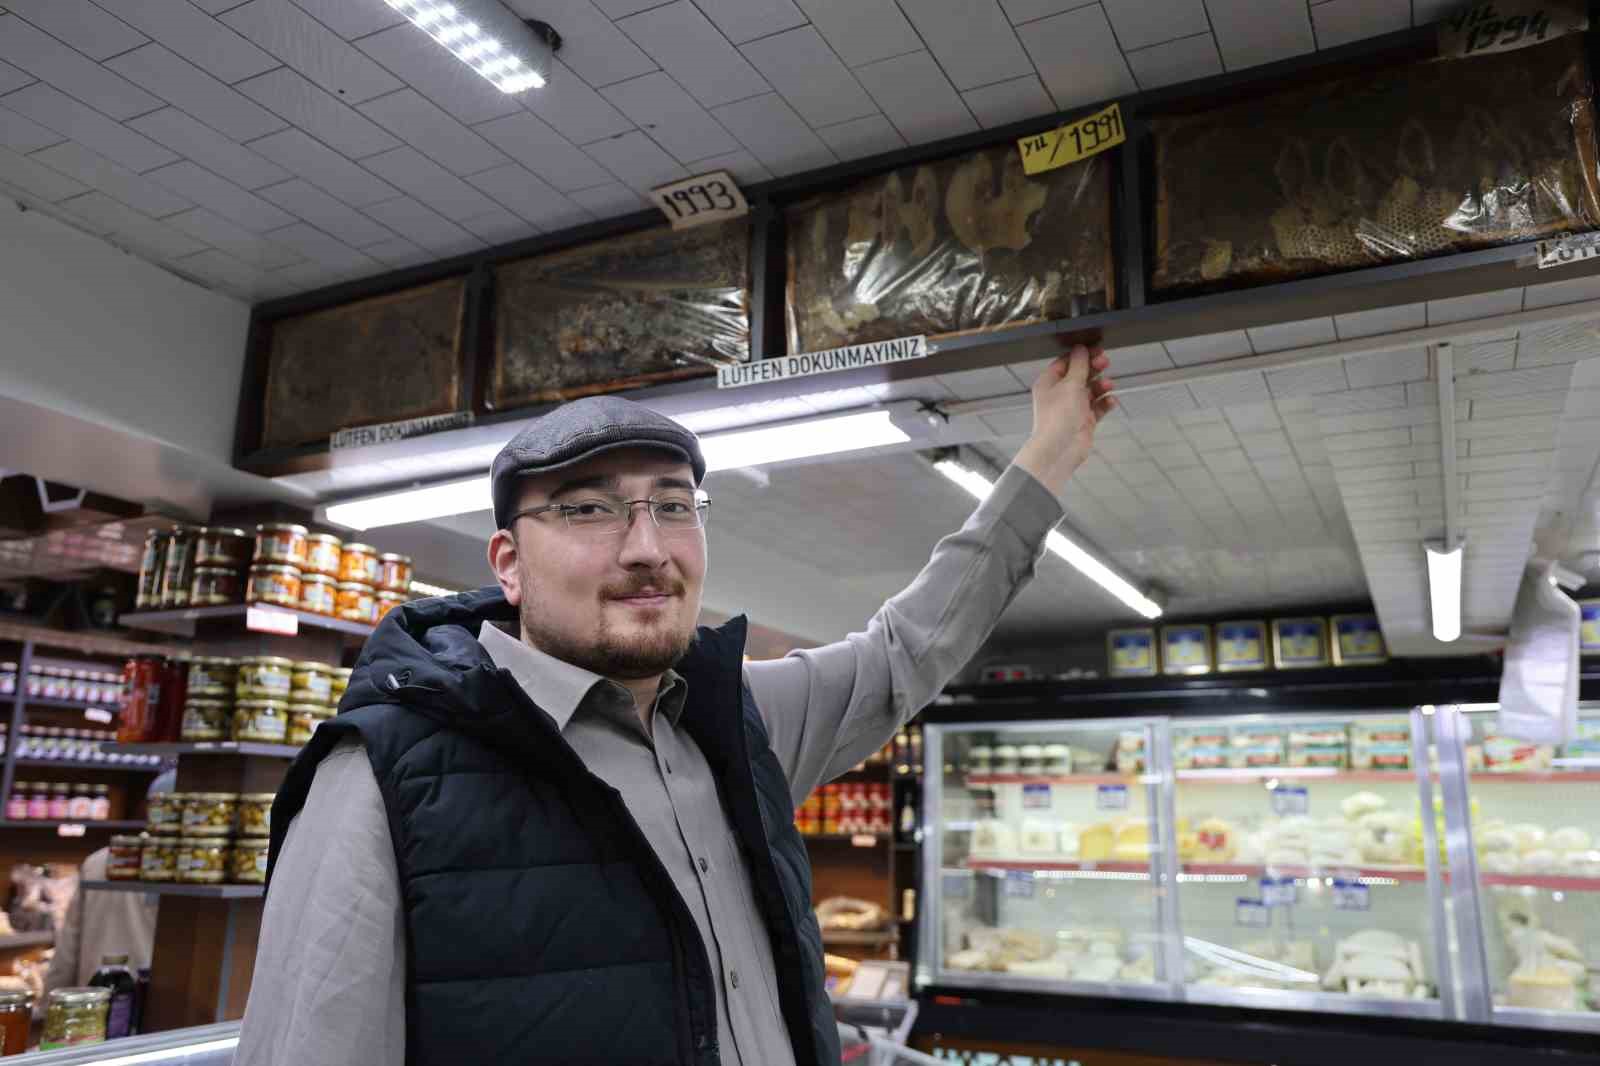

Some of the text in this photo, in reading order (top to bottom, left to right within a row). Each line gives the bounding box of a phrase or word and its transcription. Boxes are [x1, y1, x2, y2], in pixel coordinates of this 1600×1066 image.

[662, 181, 737, 217] 1993
[721, 339, 921, 387] LÜTFEN DOKUNMAYINIZ
